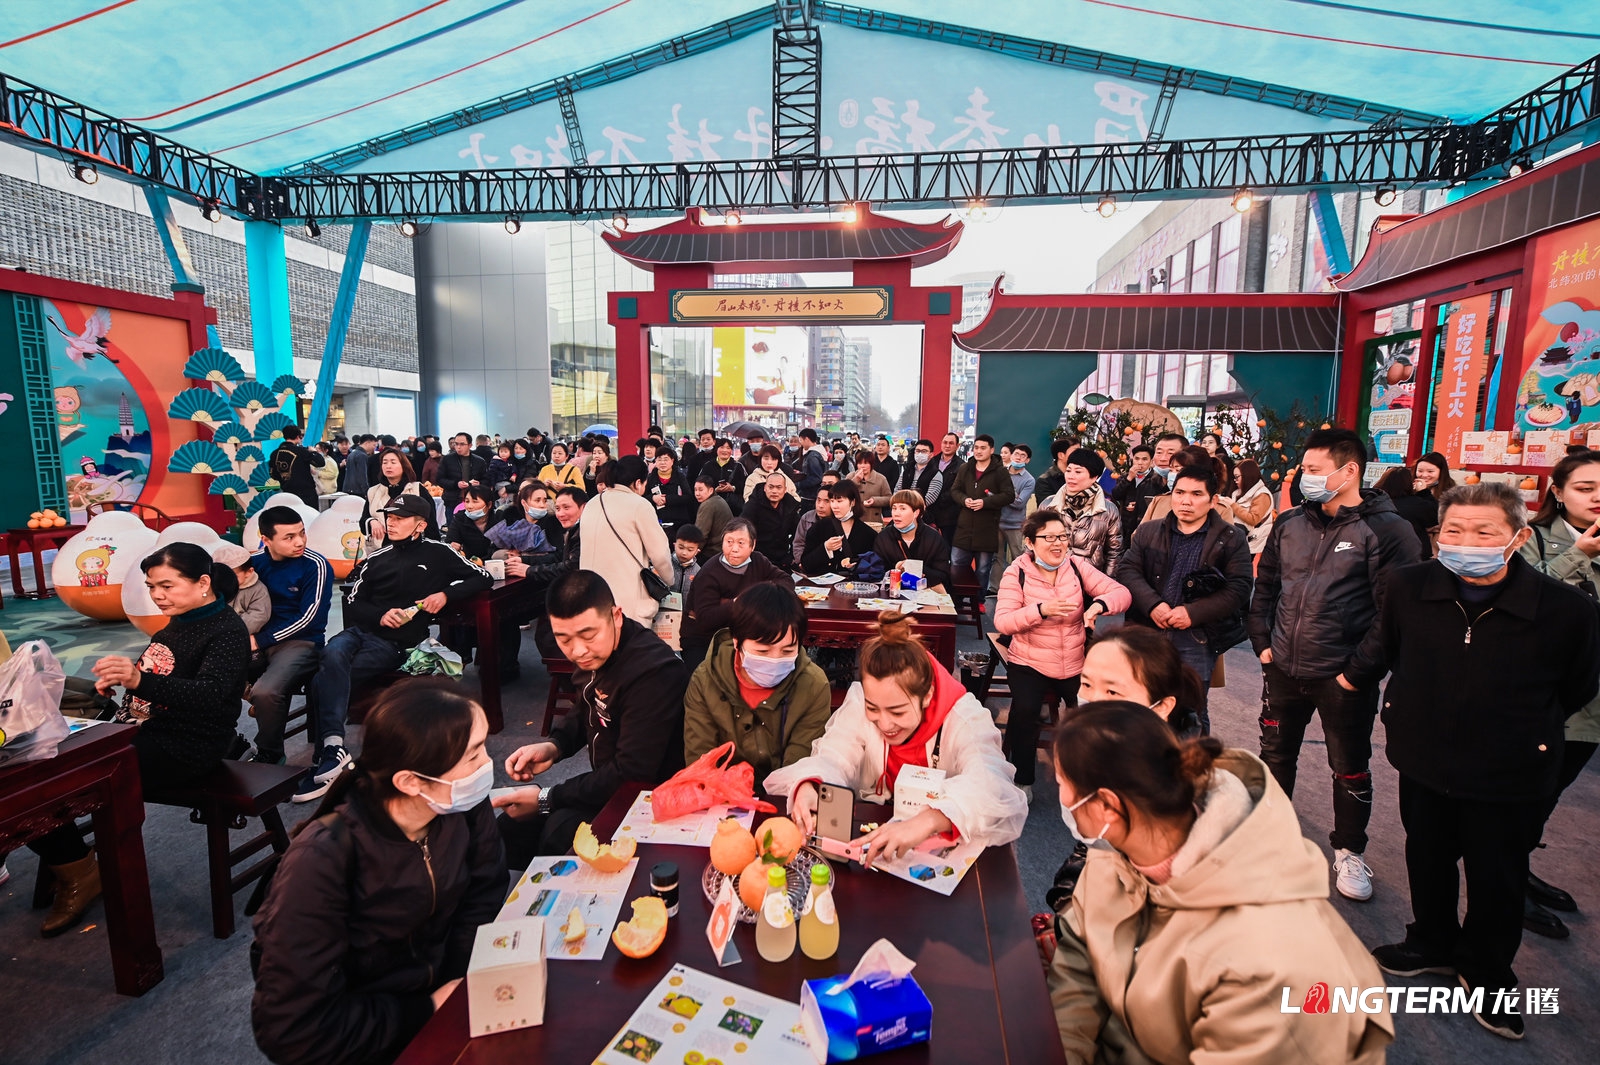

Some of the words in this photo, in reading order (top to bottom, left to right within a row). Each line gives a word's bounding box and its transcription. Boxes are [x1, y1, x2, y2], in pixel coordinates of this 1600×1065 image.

[1547, 268, 1600, 289] 北纬30°的
[1447, 312, 1476, 419] 好吃不上火
